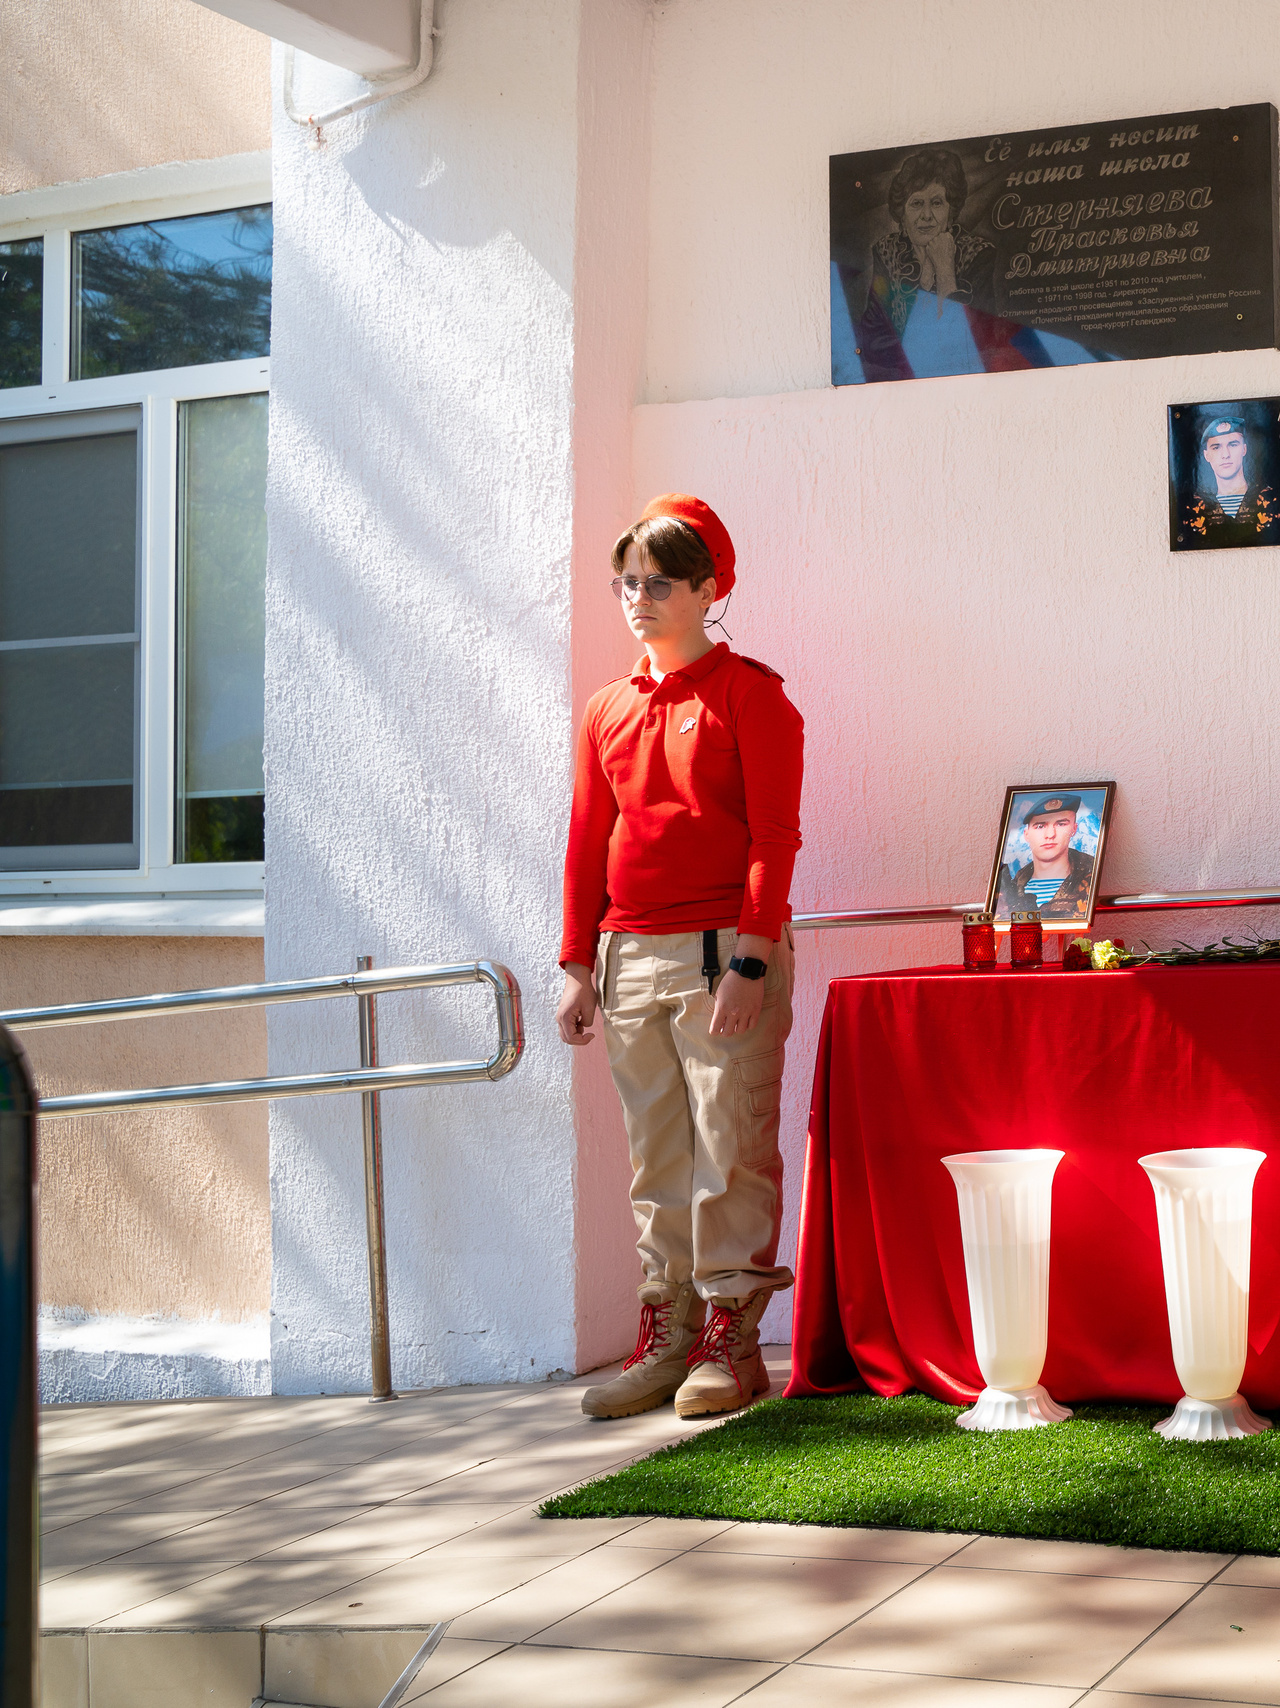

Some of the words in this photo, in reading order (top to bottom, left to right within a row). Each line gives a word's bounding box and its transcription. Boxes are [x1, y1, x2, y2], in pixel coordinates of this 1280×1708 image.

[984, 137, 1012, 162] Её
[1027, 136, 1091, 158] имя
[1108, 124, 1201, 148] носит
[1006, 164, 1085, 187] наша
[1100, 152, 1192, 177] школа
[991, 186, 1214, 230] Стерняева
[1027, 220, 1199, 257] Прасковья
[1005, 246, 1211, 279] Дмитриевна
[1009, 287, 1044, 297] работала
[1052, 284, 1069, 292] этой
[1131, 276, 1149, 285] 2010
[1151, 276, 1164, 284] год
[1044, 294, 1060, 302] 1971
[1076, 292, 1092, 300] 1998
[1113, 287, 1158, 297] директором
[1040, 305, 1078, 315] народного
[1196, 292, 1226, 301] учитель
[1074, 312, 1114, 322] гражданин
[1116, 306, 1177, 318] муниципального
[1178, 302, 1228, 312] образования
[1081, 320, 1130, 331] город-курорт
